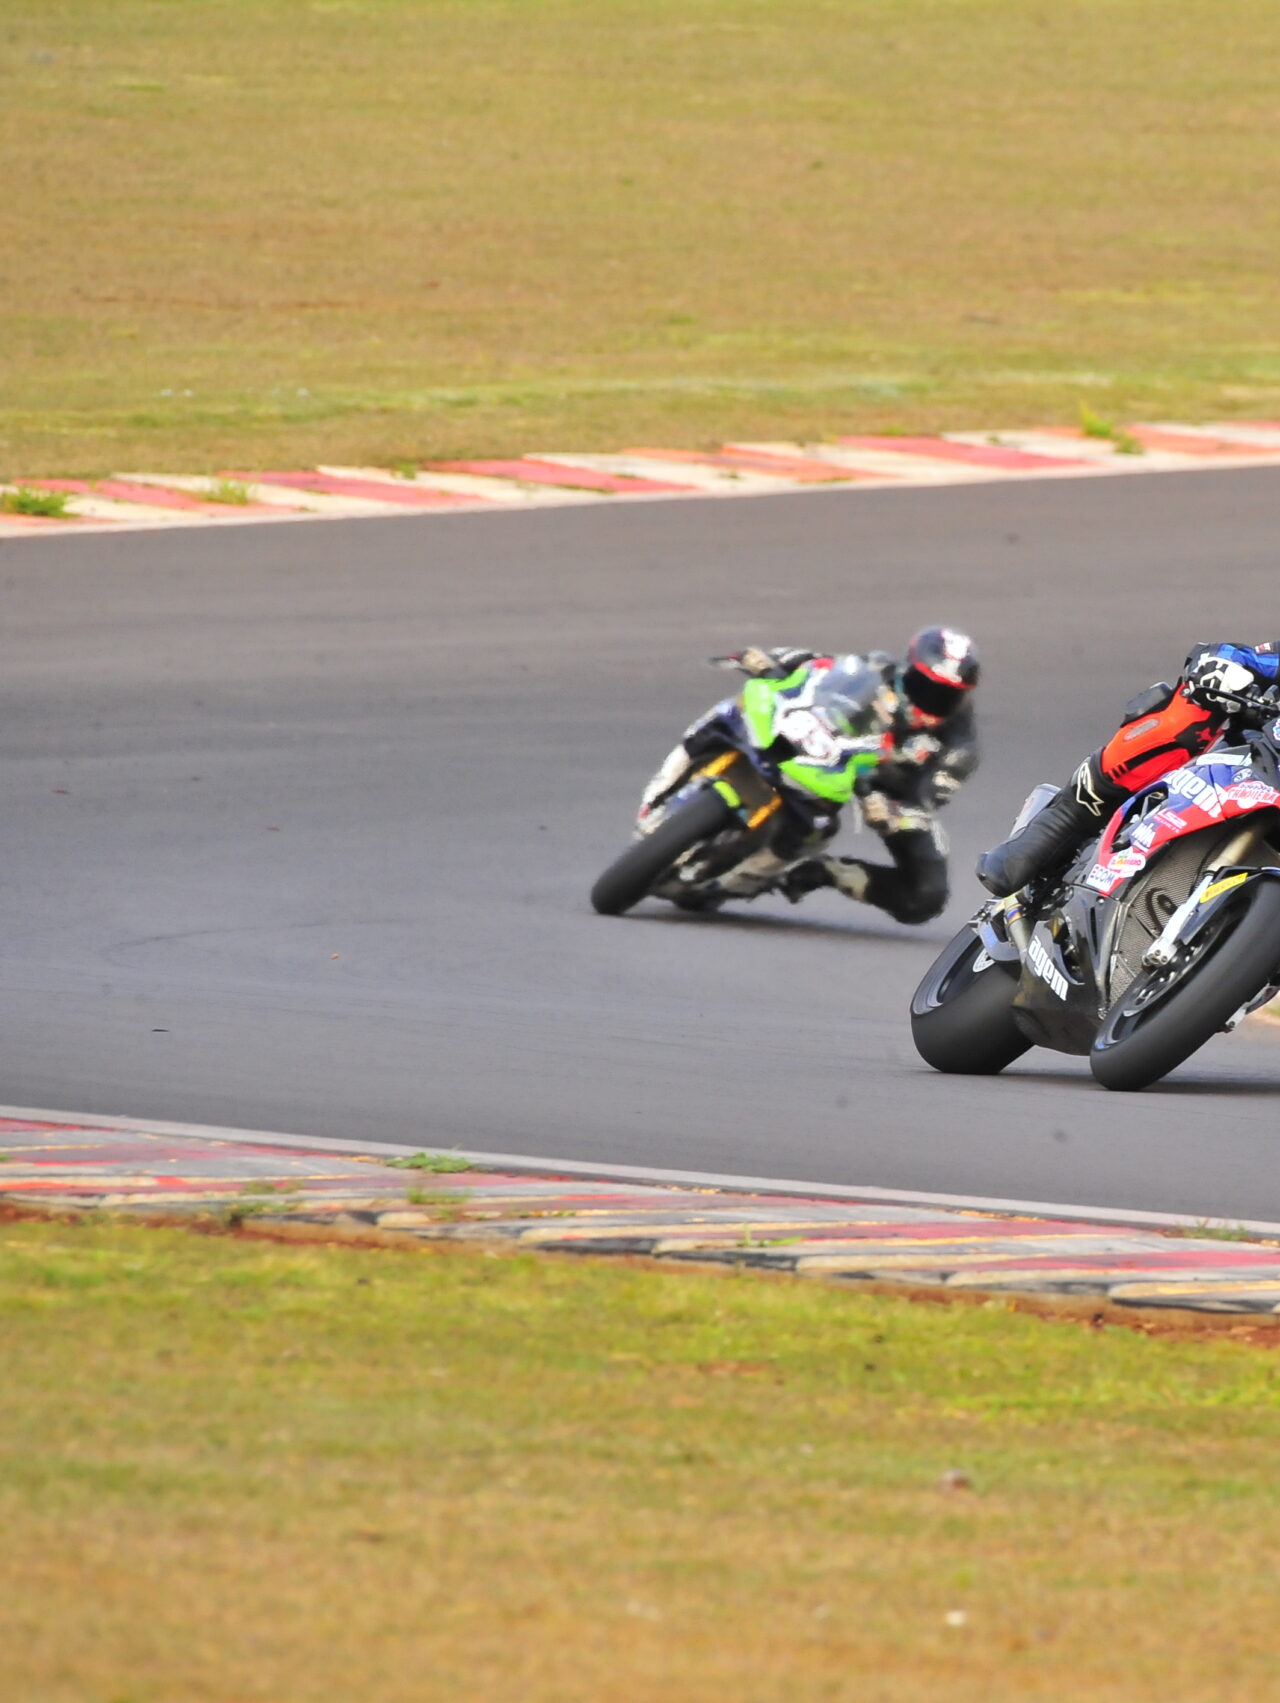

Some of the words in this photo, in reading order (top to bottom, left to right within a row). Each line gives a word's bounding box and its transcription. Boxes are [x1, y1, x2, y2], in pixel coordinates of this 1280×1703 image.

[1153, 815, 1180, 833] HELMETS
[1156, 807, 1188, 829] LS2
[1090, 865, 1118, 884] ECOM
[1028, 935, 1069, 1002] agem
